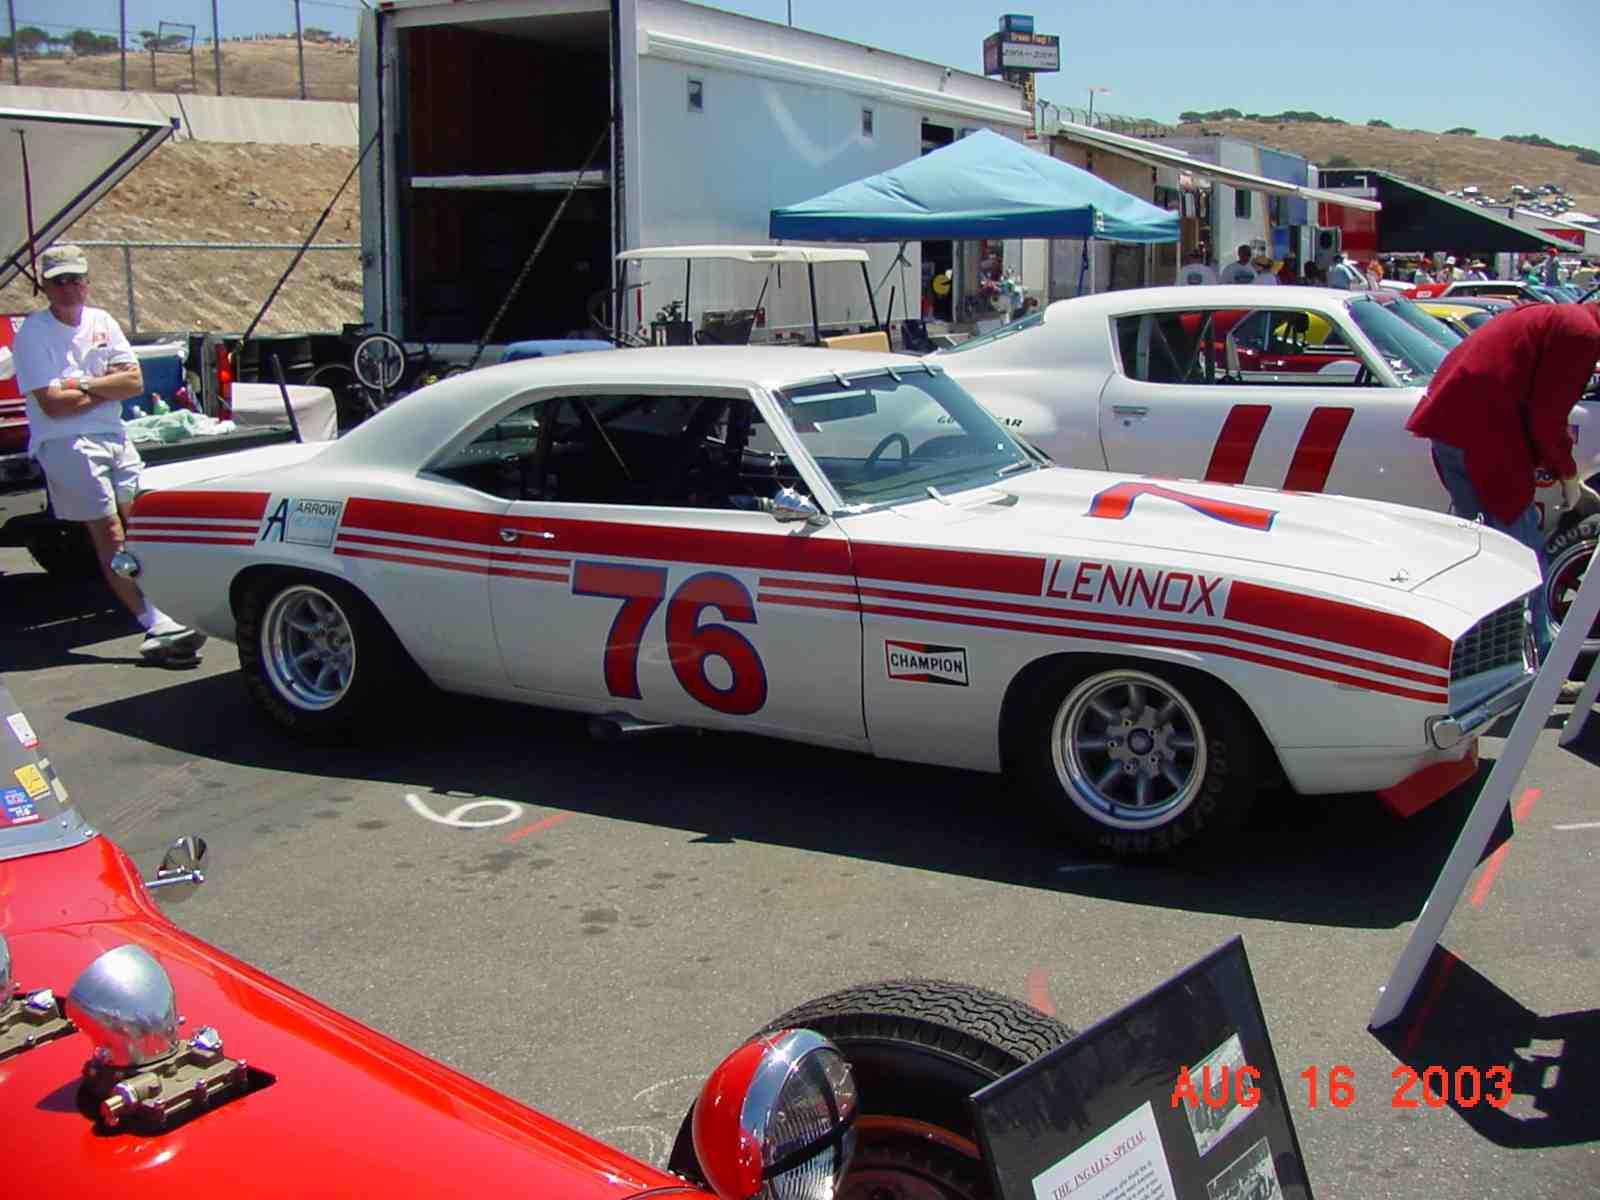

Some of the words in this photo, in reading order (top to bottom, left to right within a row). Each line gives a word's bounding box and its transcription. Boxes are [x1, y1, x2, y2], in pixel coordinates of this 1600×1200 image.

[297, 502, 338, 517] ARROW
[1046, 559, 1223, 617] LENNOX
[572, 559, 768, 716] 76
[890, 653, 963, 673] CHAMPION
